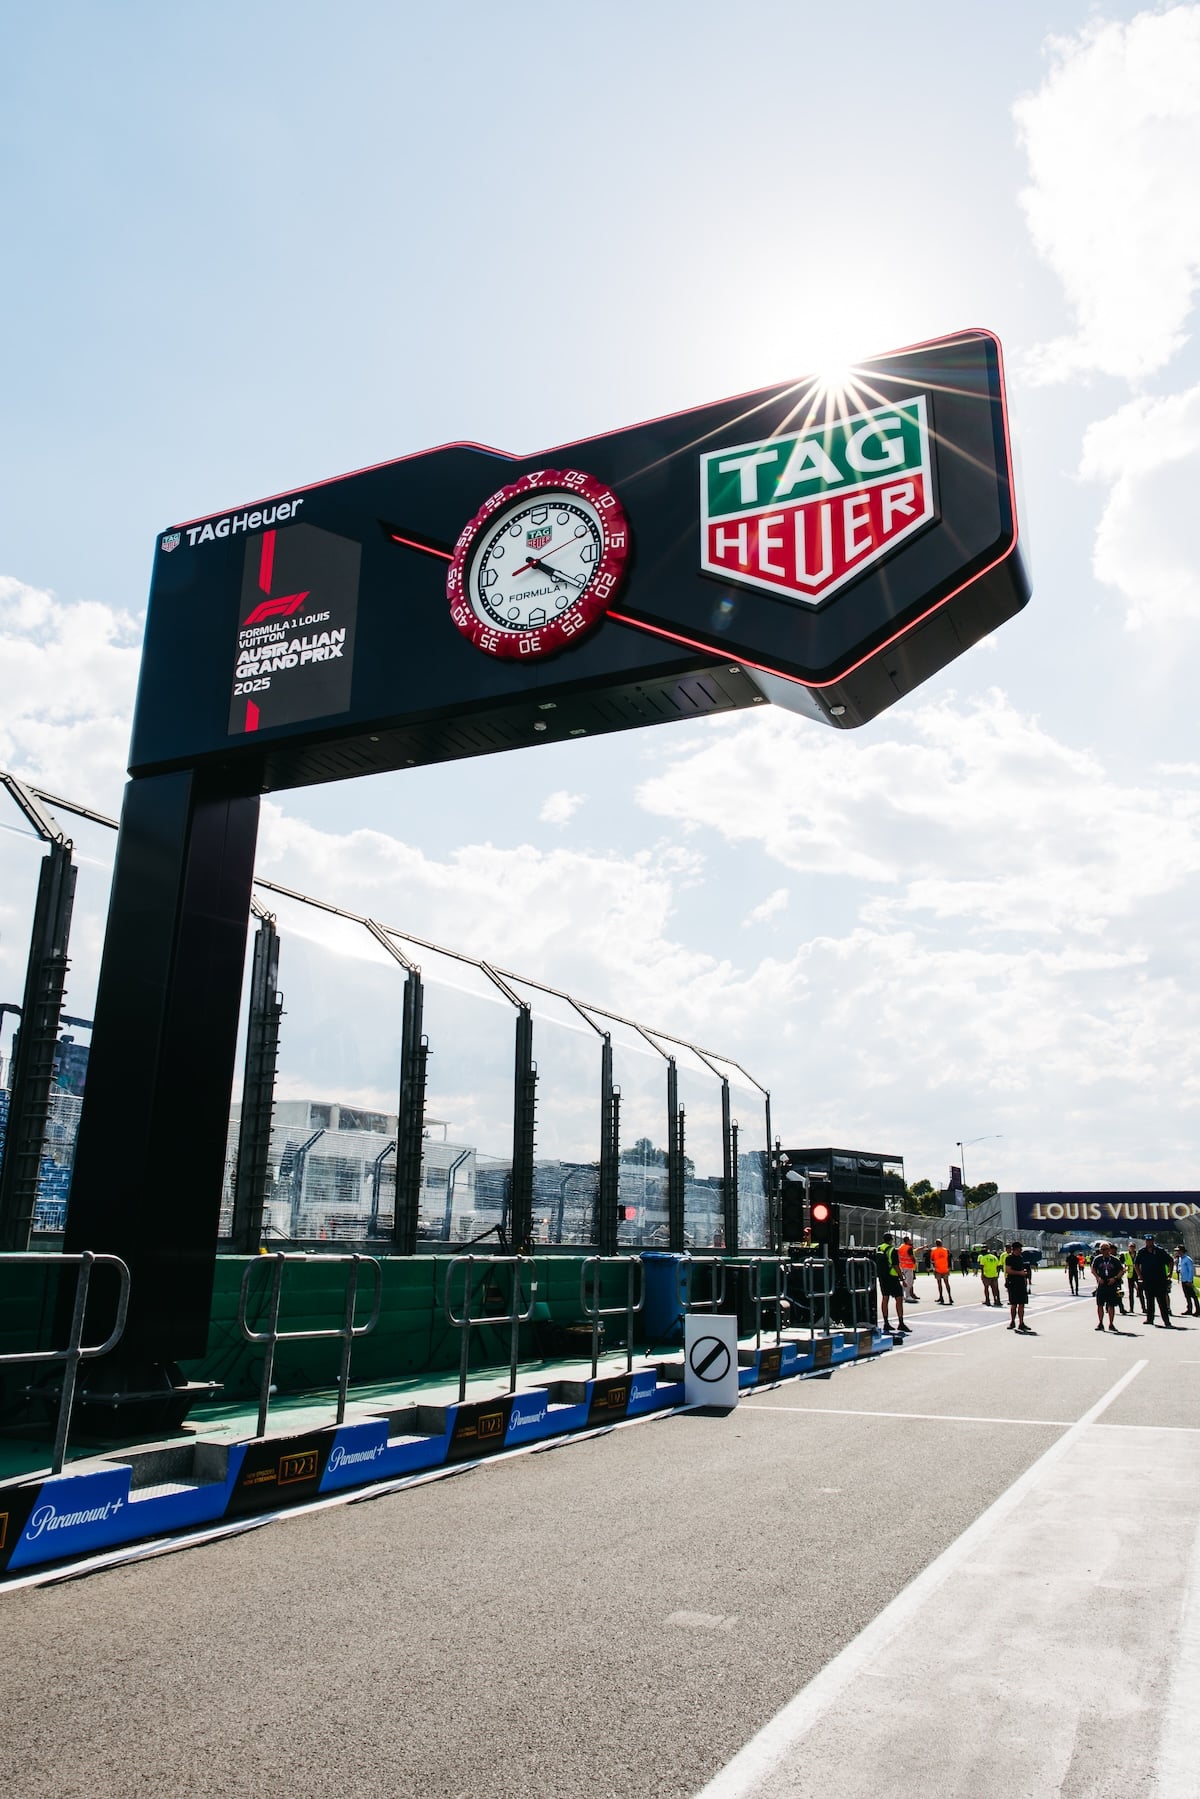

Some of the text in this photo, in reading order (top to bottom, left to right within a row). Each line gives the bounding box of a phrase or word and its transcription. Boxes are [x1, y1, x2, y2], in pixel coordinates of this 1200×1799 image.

[719, 417, 905, 504] TAG
[565, 471, 588, 485] 05
[485, 490, 504, 509] 55
[598, 491, 616, 508] 10
[163, 534, 178, 543] TAG
[457, 526, 472, 546] 50
[528, 536, 551, 549] HEUER
[529, 528, 550, 539] TAG
[611, 531, 625, 548] 15
[716, 482, 916, 587] HEUER
[509, 584, 561, 602] FORMULA
[595, 572, 617, 598] 20
[240, 611, 330, 640] FORMULA 1 LOUIS
[453, 606, 467, 626] 40
[561, 613, 586, 636] 25
[236, 628, 346, 665] AUSTRALIAN
[239, 631, 285, 648] VUITTON
[480, 633, 499, 652] 35
[519, 637, 541, 654] 30
[235, 642, 344, 678] GRAND PRIX
[234, 677, 271, 696] 2025
[1034, 1202, 1101, 1221] LOUIS
[284, 1456, 314, 1478] 1923
[328, 1443, 385, 1473] Paramount+
[26, 1498, 124, 1540] Paramount+
